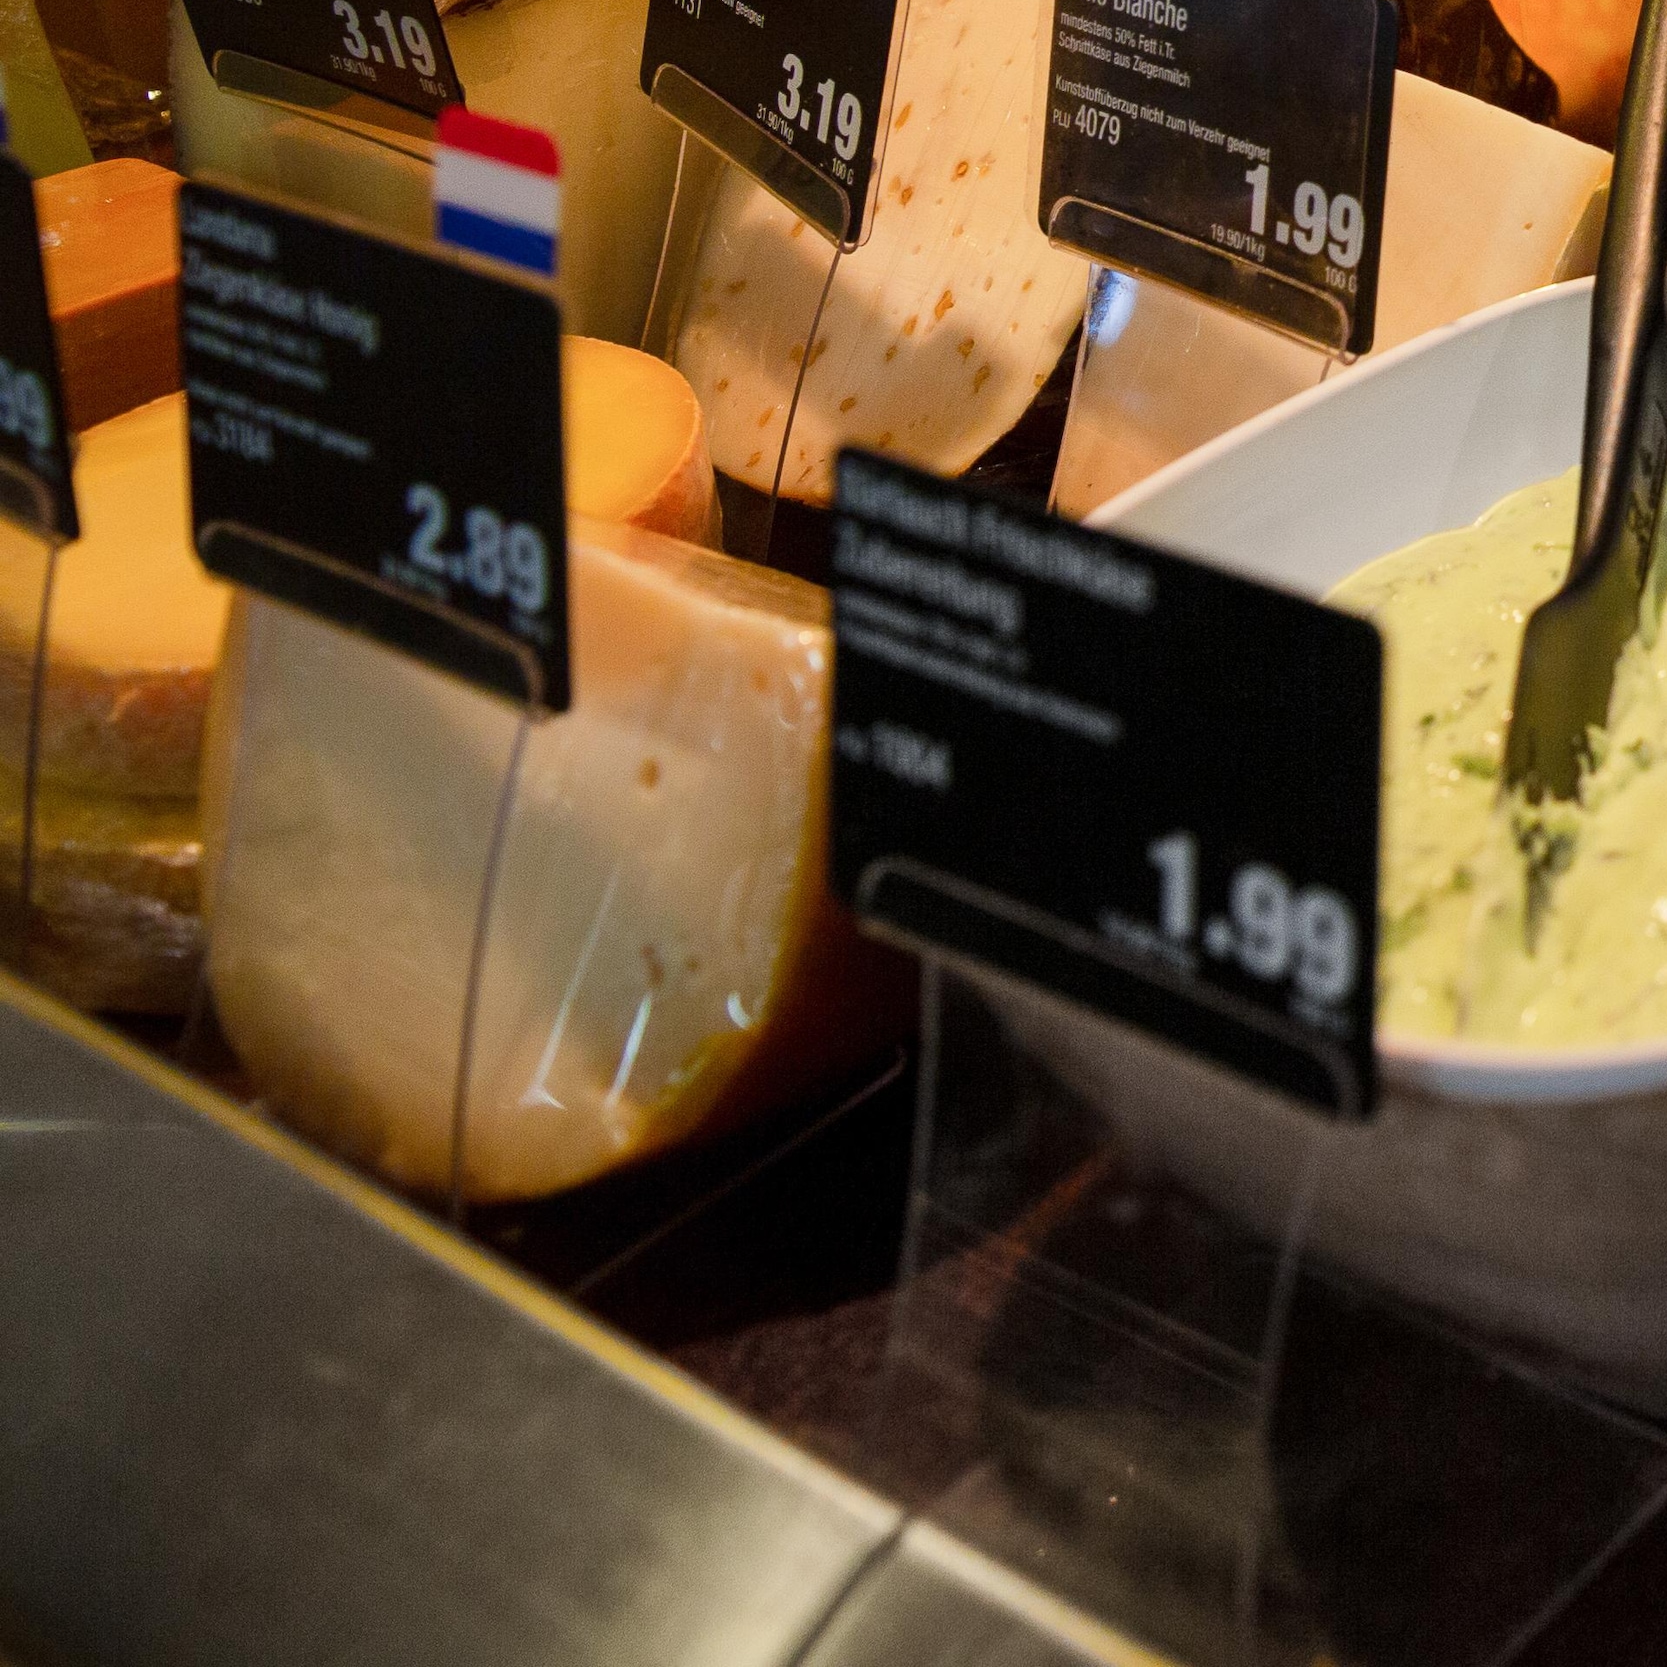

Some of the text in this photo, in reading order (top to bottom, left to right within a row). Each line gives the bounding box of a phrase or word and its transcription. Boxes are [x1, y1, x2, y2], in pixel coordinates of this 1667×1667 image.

[1060, 11, 1157, 55] mindestens 50% Fett
[1057, 31, 1191, 90] Schnittkäse aus Ziegenmilch
[756, 103, 794, 145] 31.90/1kg
[777, 52, 863, 161] 3.19
[1052, 104, 1122, 147] PLU 4079
[1055, 72, 1271, 165] Kunststoffüberzug nicht zum Verzehr geeignet
[832, 156, 846, 181] 100
[1244, 162, 1364, 270] 1.99
[1210, 222, 1266, 263] 19.90/1kg
[1324, 263, 1346, 289] 100
[406, 482, 549, 614] 2.89
[1146, 832, 1357, 1009] 1.99
